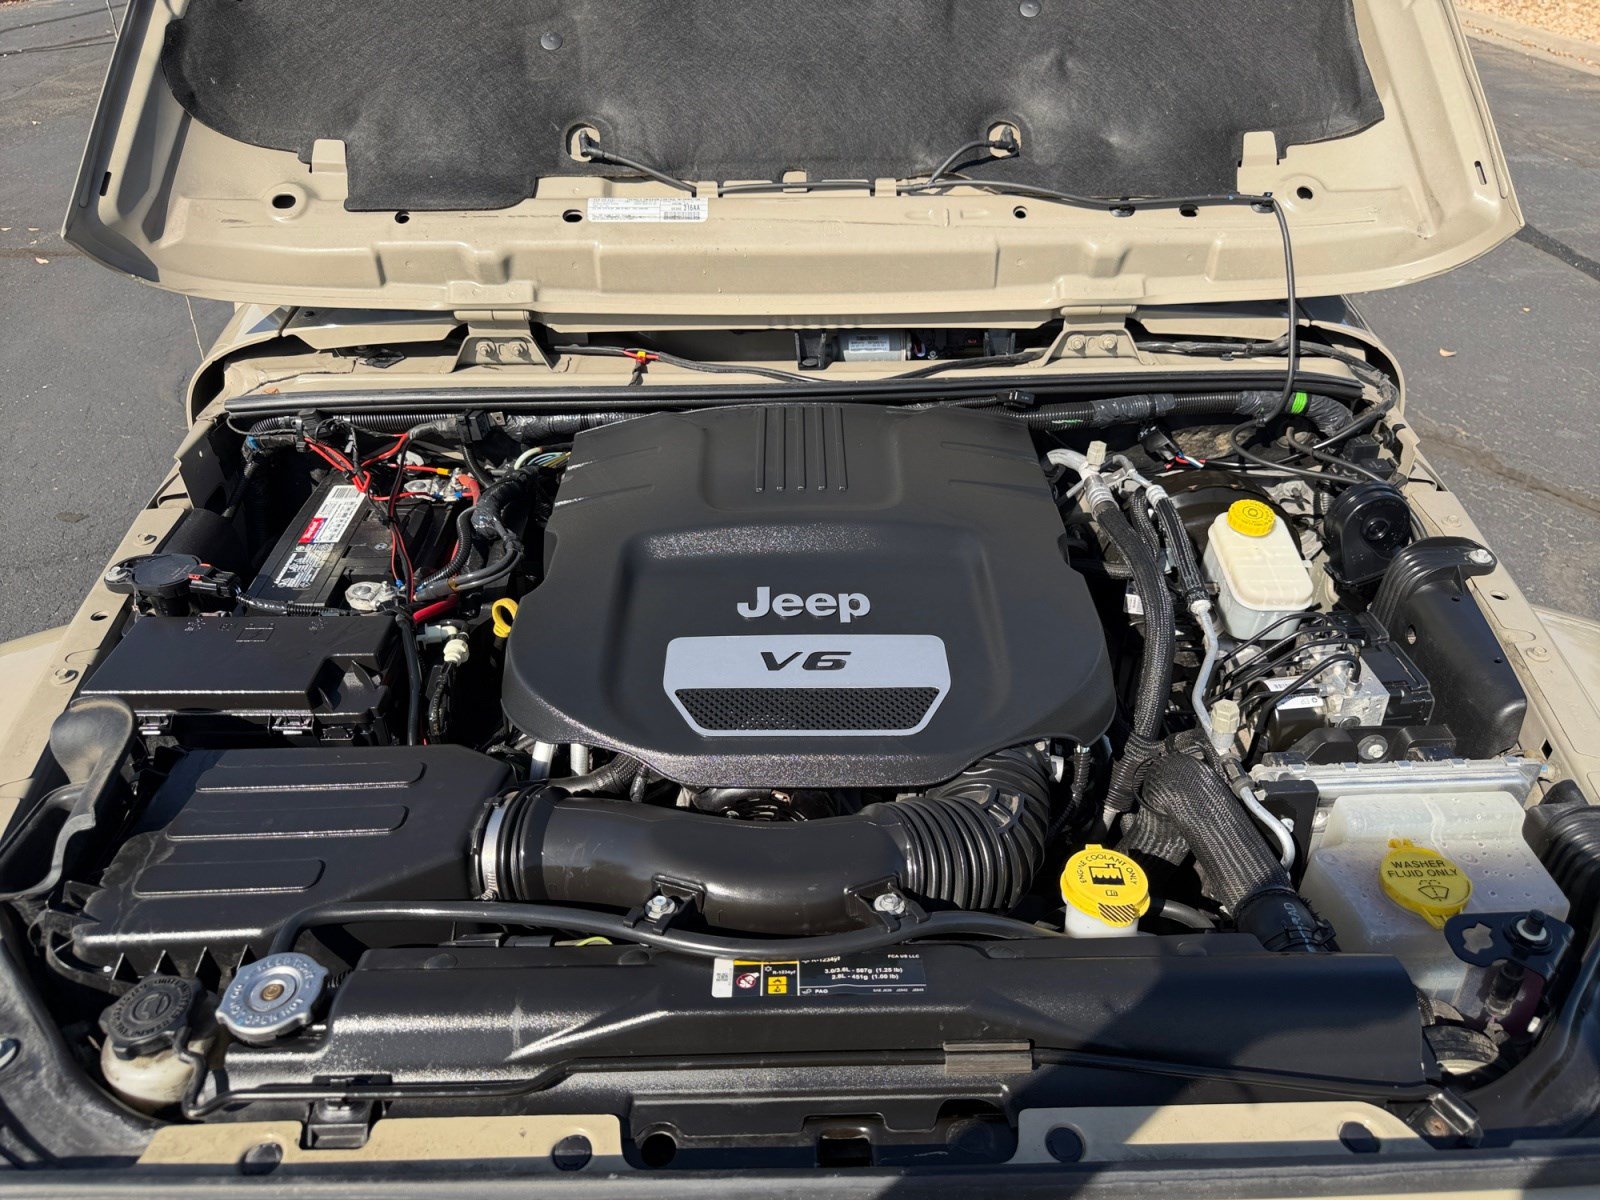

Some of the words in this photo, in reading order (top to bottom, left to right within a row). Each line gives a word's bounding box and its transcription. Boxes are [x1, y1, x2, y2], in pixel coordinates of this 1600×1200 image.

[737, 586, 871, 623] Jeep
[760, 651, 852, 671] V6
[1077, 859, 1088, 884] ENGINE
[1085, 854, 1127, 867] COOLANT
[1126, 867, 1138, 886] ONLY
[1387, 870, 1423, 878] FLUID
[1427, 868, 1458, 877] ONLY
[1391, 860, 1445, 869] WASHER
